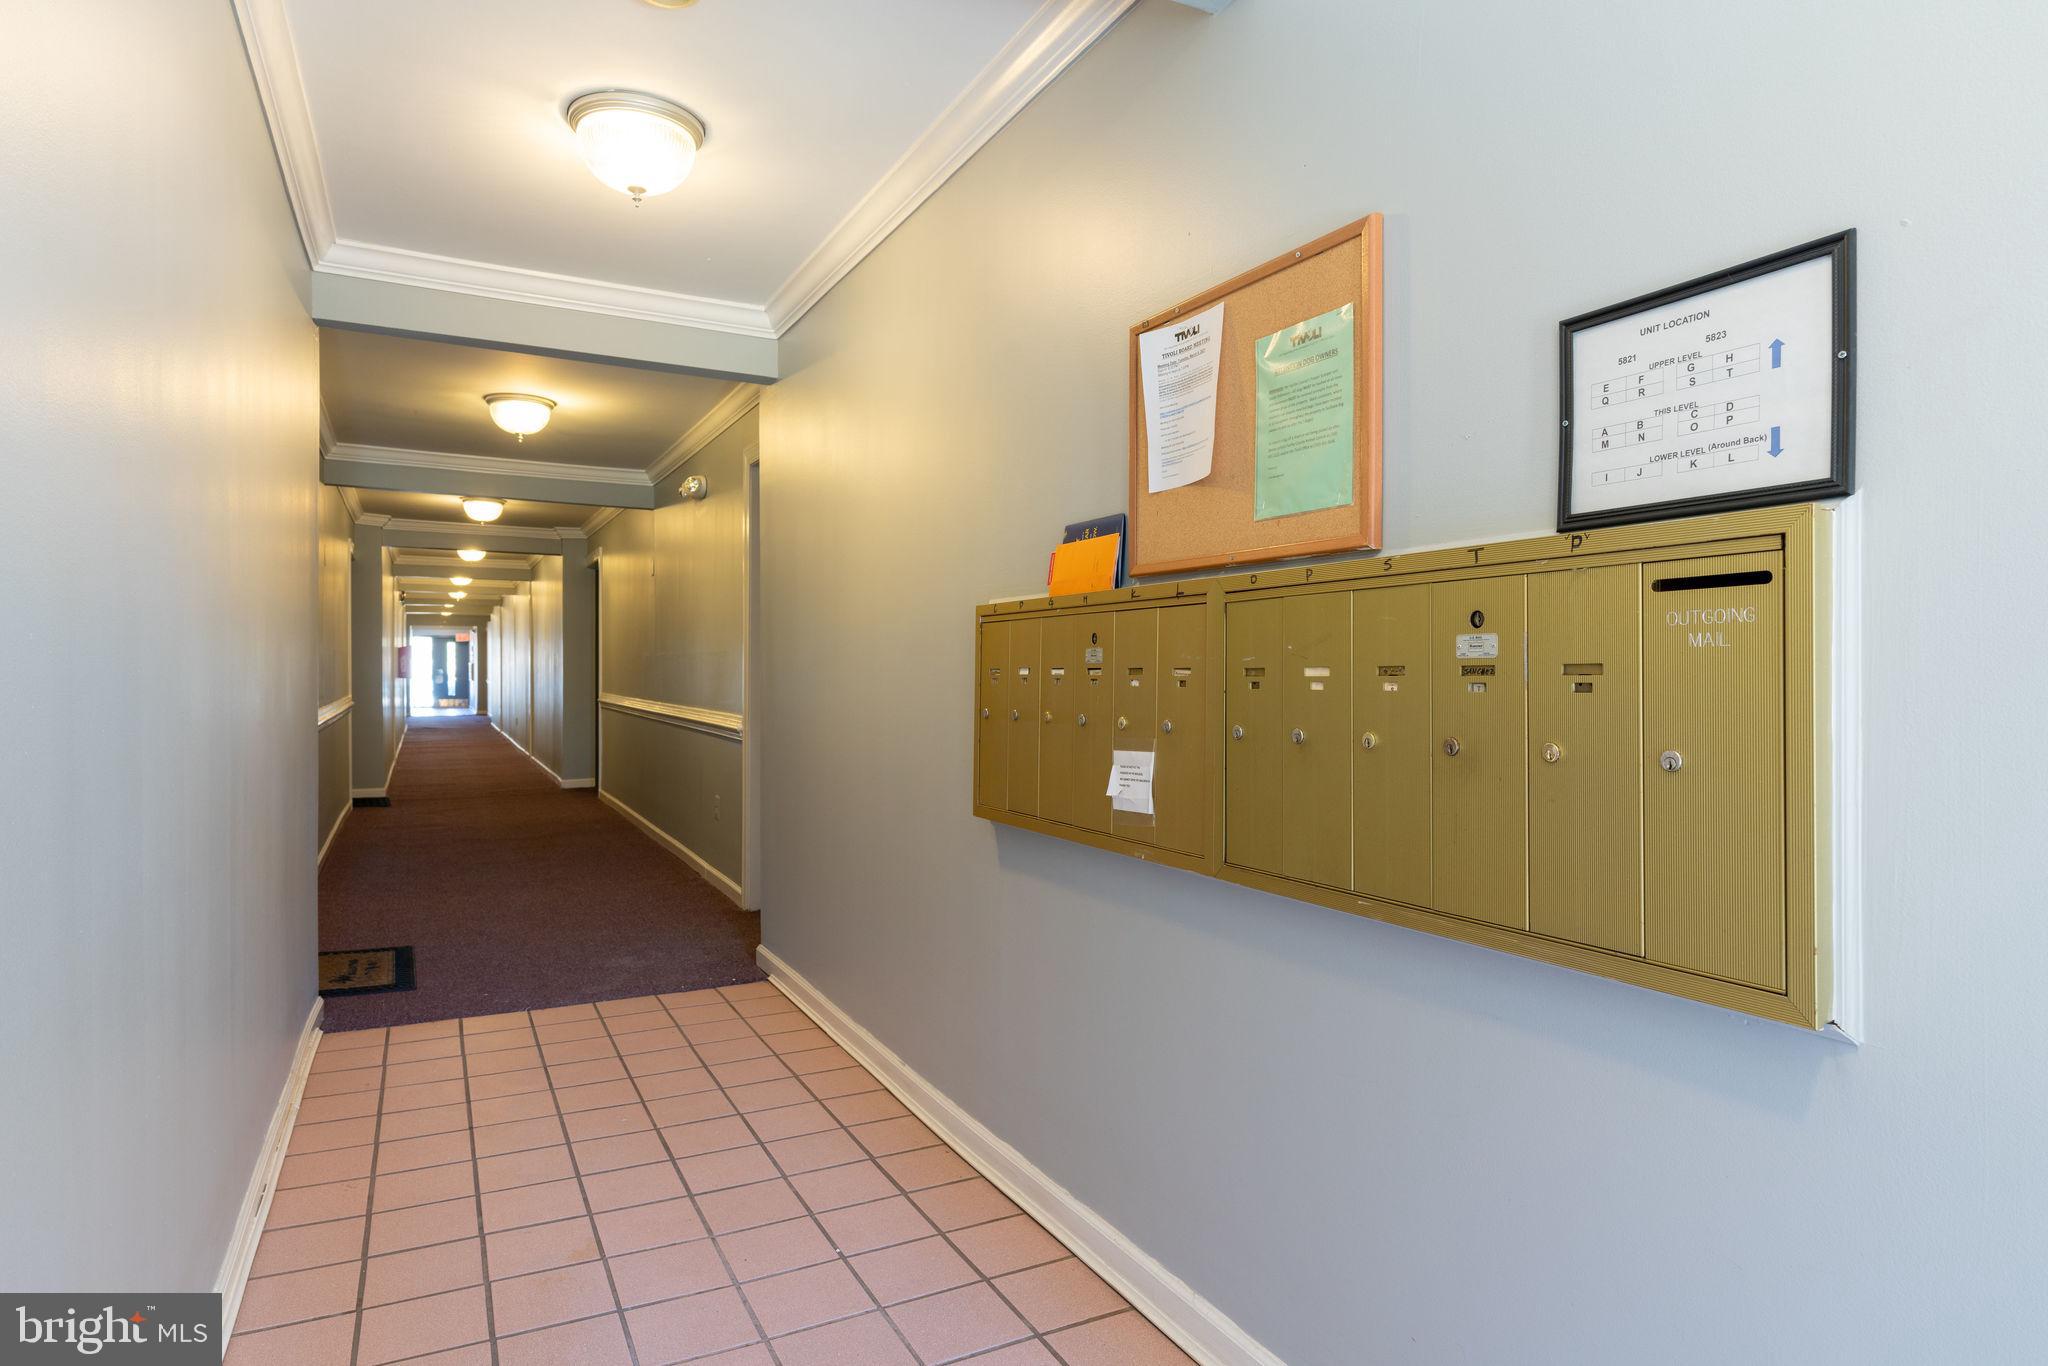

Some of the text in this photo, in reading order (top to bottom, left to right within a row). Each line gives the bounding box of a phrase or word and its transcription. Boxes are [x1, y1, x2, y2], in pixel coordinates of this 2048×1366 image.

[1639, 309, 1711, 337] UNIT LOCATION
[1705, 330, 1727, 343] 5823
[1603, 353, 1734, 393] E F G H
[1618, 354, 1637, 366] 5821
[1649, 351, 1703, 370] UPPER LEVEL
[1602, 368, 1734, 406] Q R S T
[1601, 402, 1734, 437] A B C D
[1654, 401, 1699, 417] THIS LEVEL
[1601, 415, 1733, 449] M N O P
[1649, 433, 1768, 463] LOWER LEVEL (Around Back)
[1636, 468, 1643, 477] J
[1690, 459, 1698, 469] K
[1728, 453, 1735, 463] L
[1306, 568, 1313, 583] P
[1383, 558, 1392, 571] S
[1467, 547, 1485, 564] T
[1666, 606, 1756, 627] OUTGOING
[1688, 632, 1731, 648] MAIL
